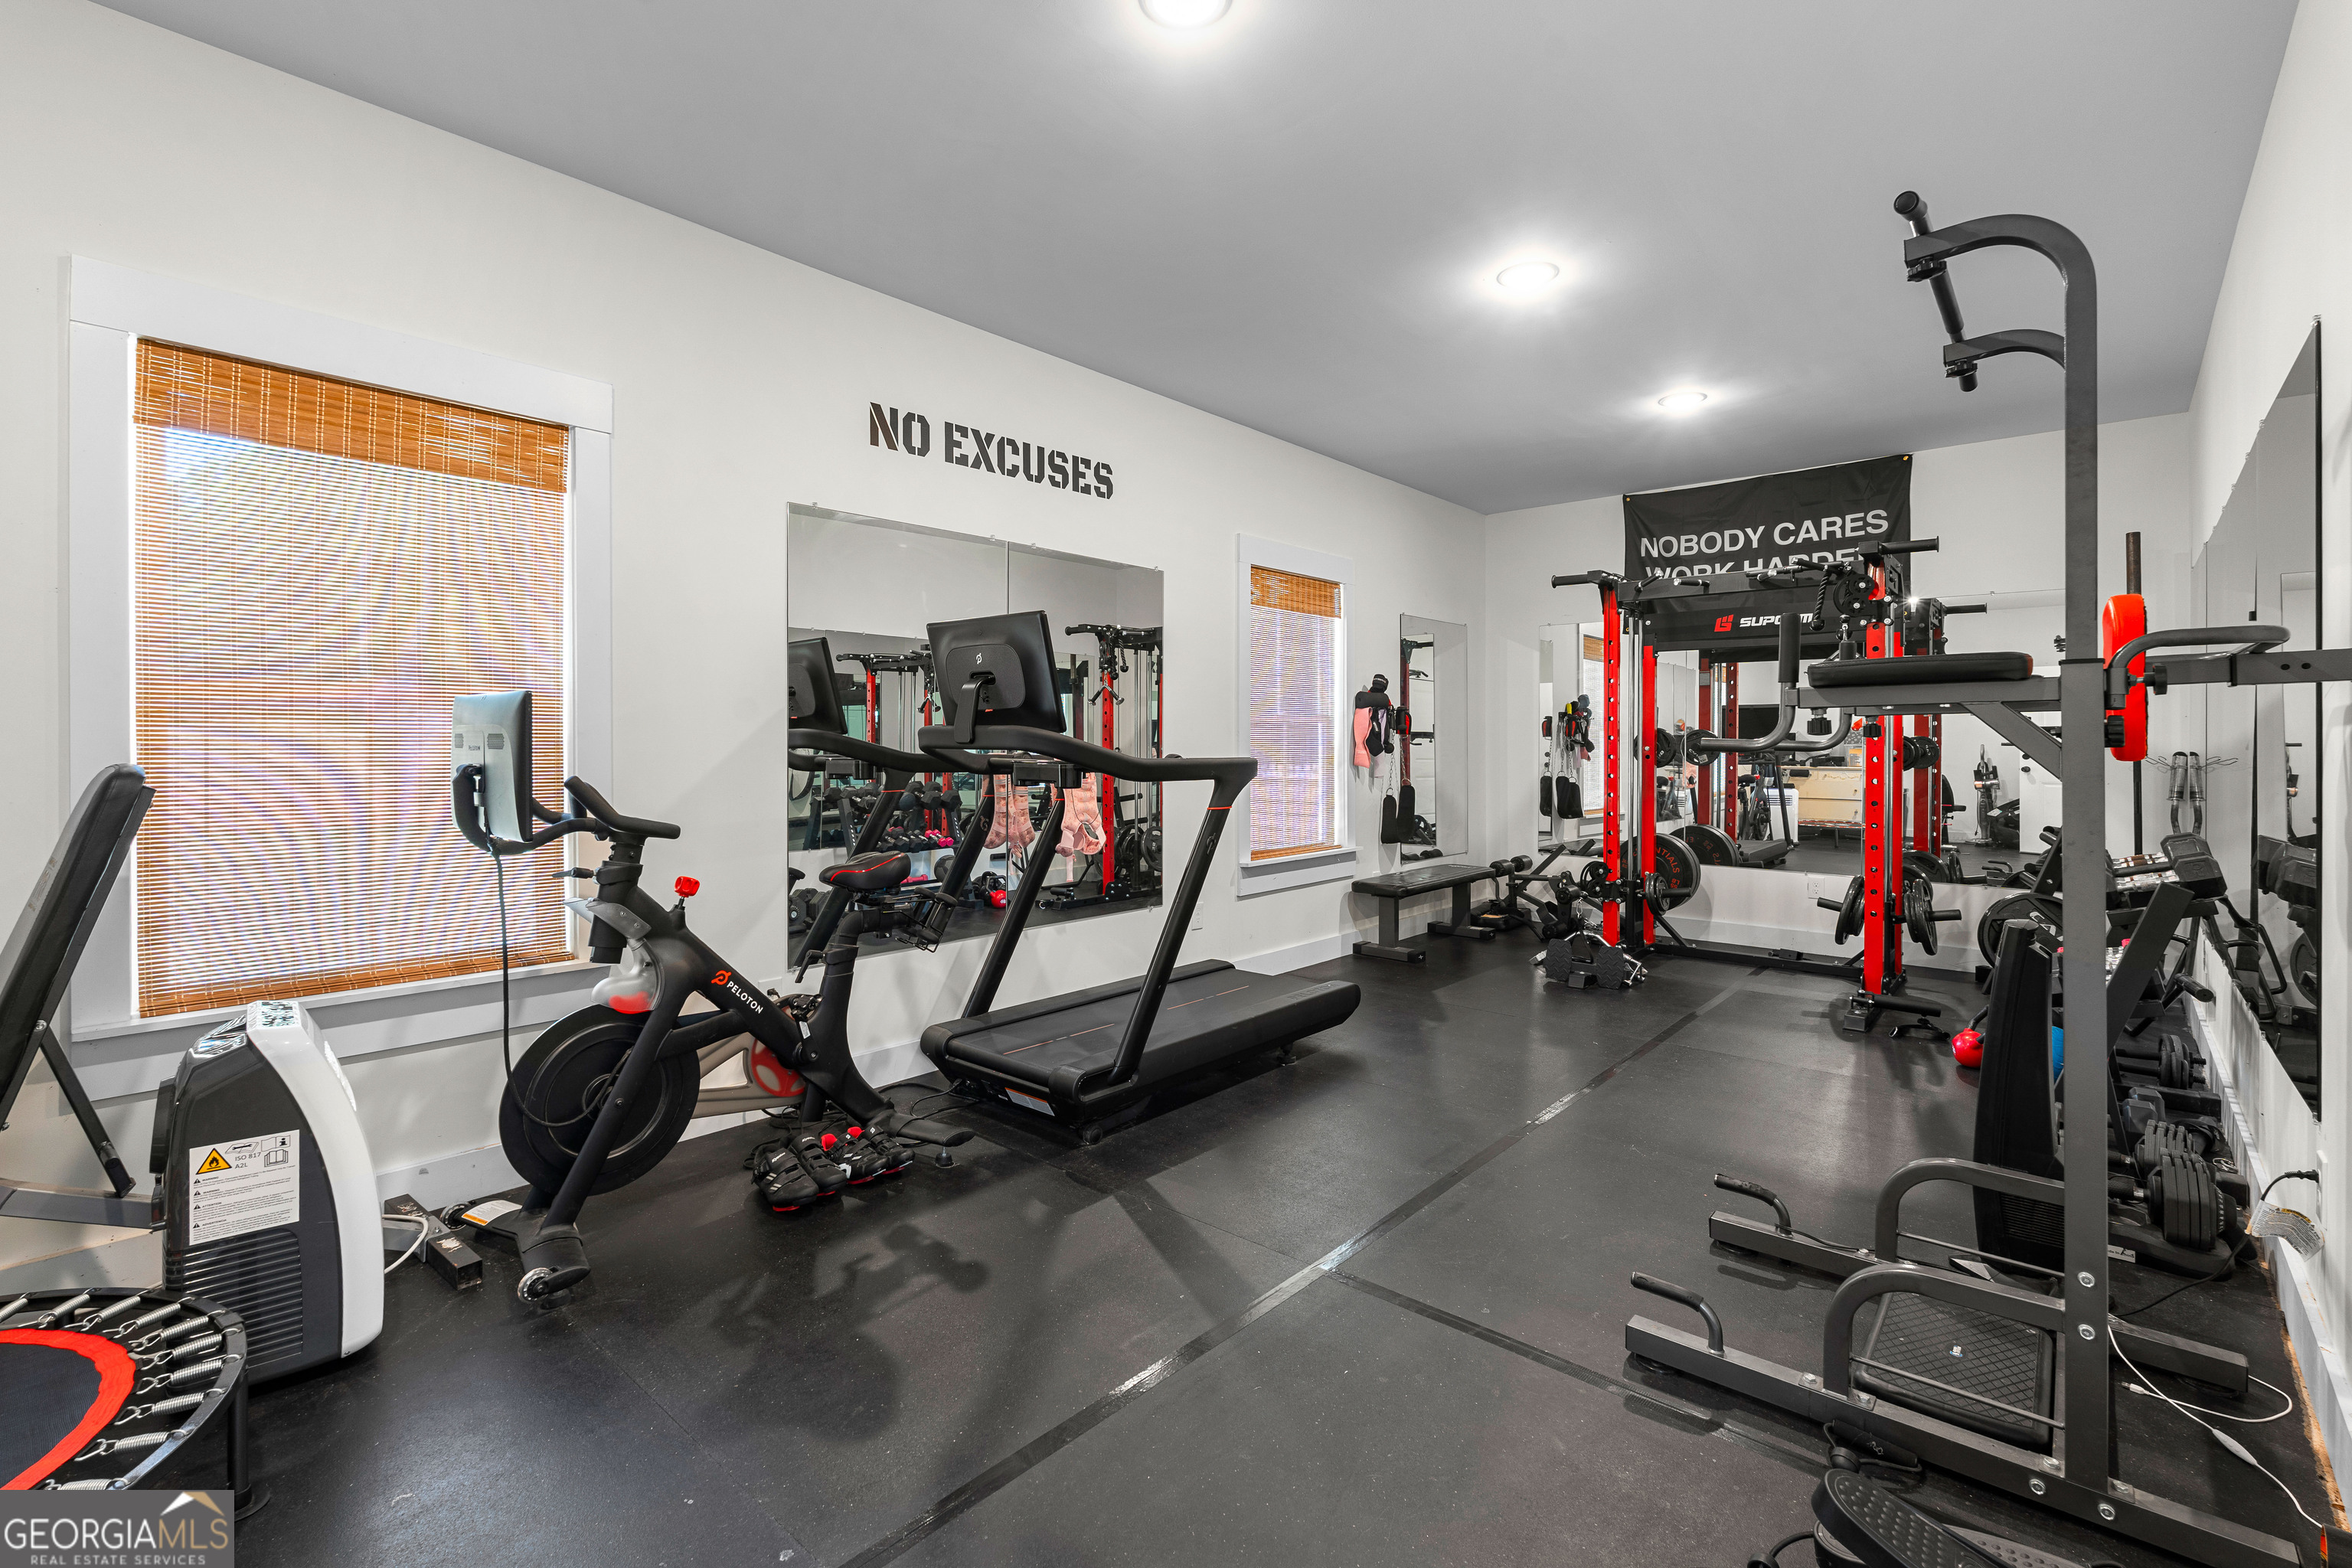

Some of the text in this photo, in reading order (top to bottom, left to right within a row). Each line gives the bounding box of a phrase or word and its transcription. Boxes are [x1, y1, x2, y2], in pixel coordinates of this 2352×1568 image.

[869, 402, 1114, 500] NO EXCUSES
[1641, 509, 1889, 558] NOBODY CARES
[2029, 911, 2064, 942] CA
[727, 981, 763, 1014] PELOTON
